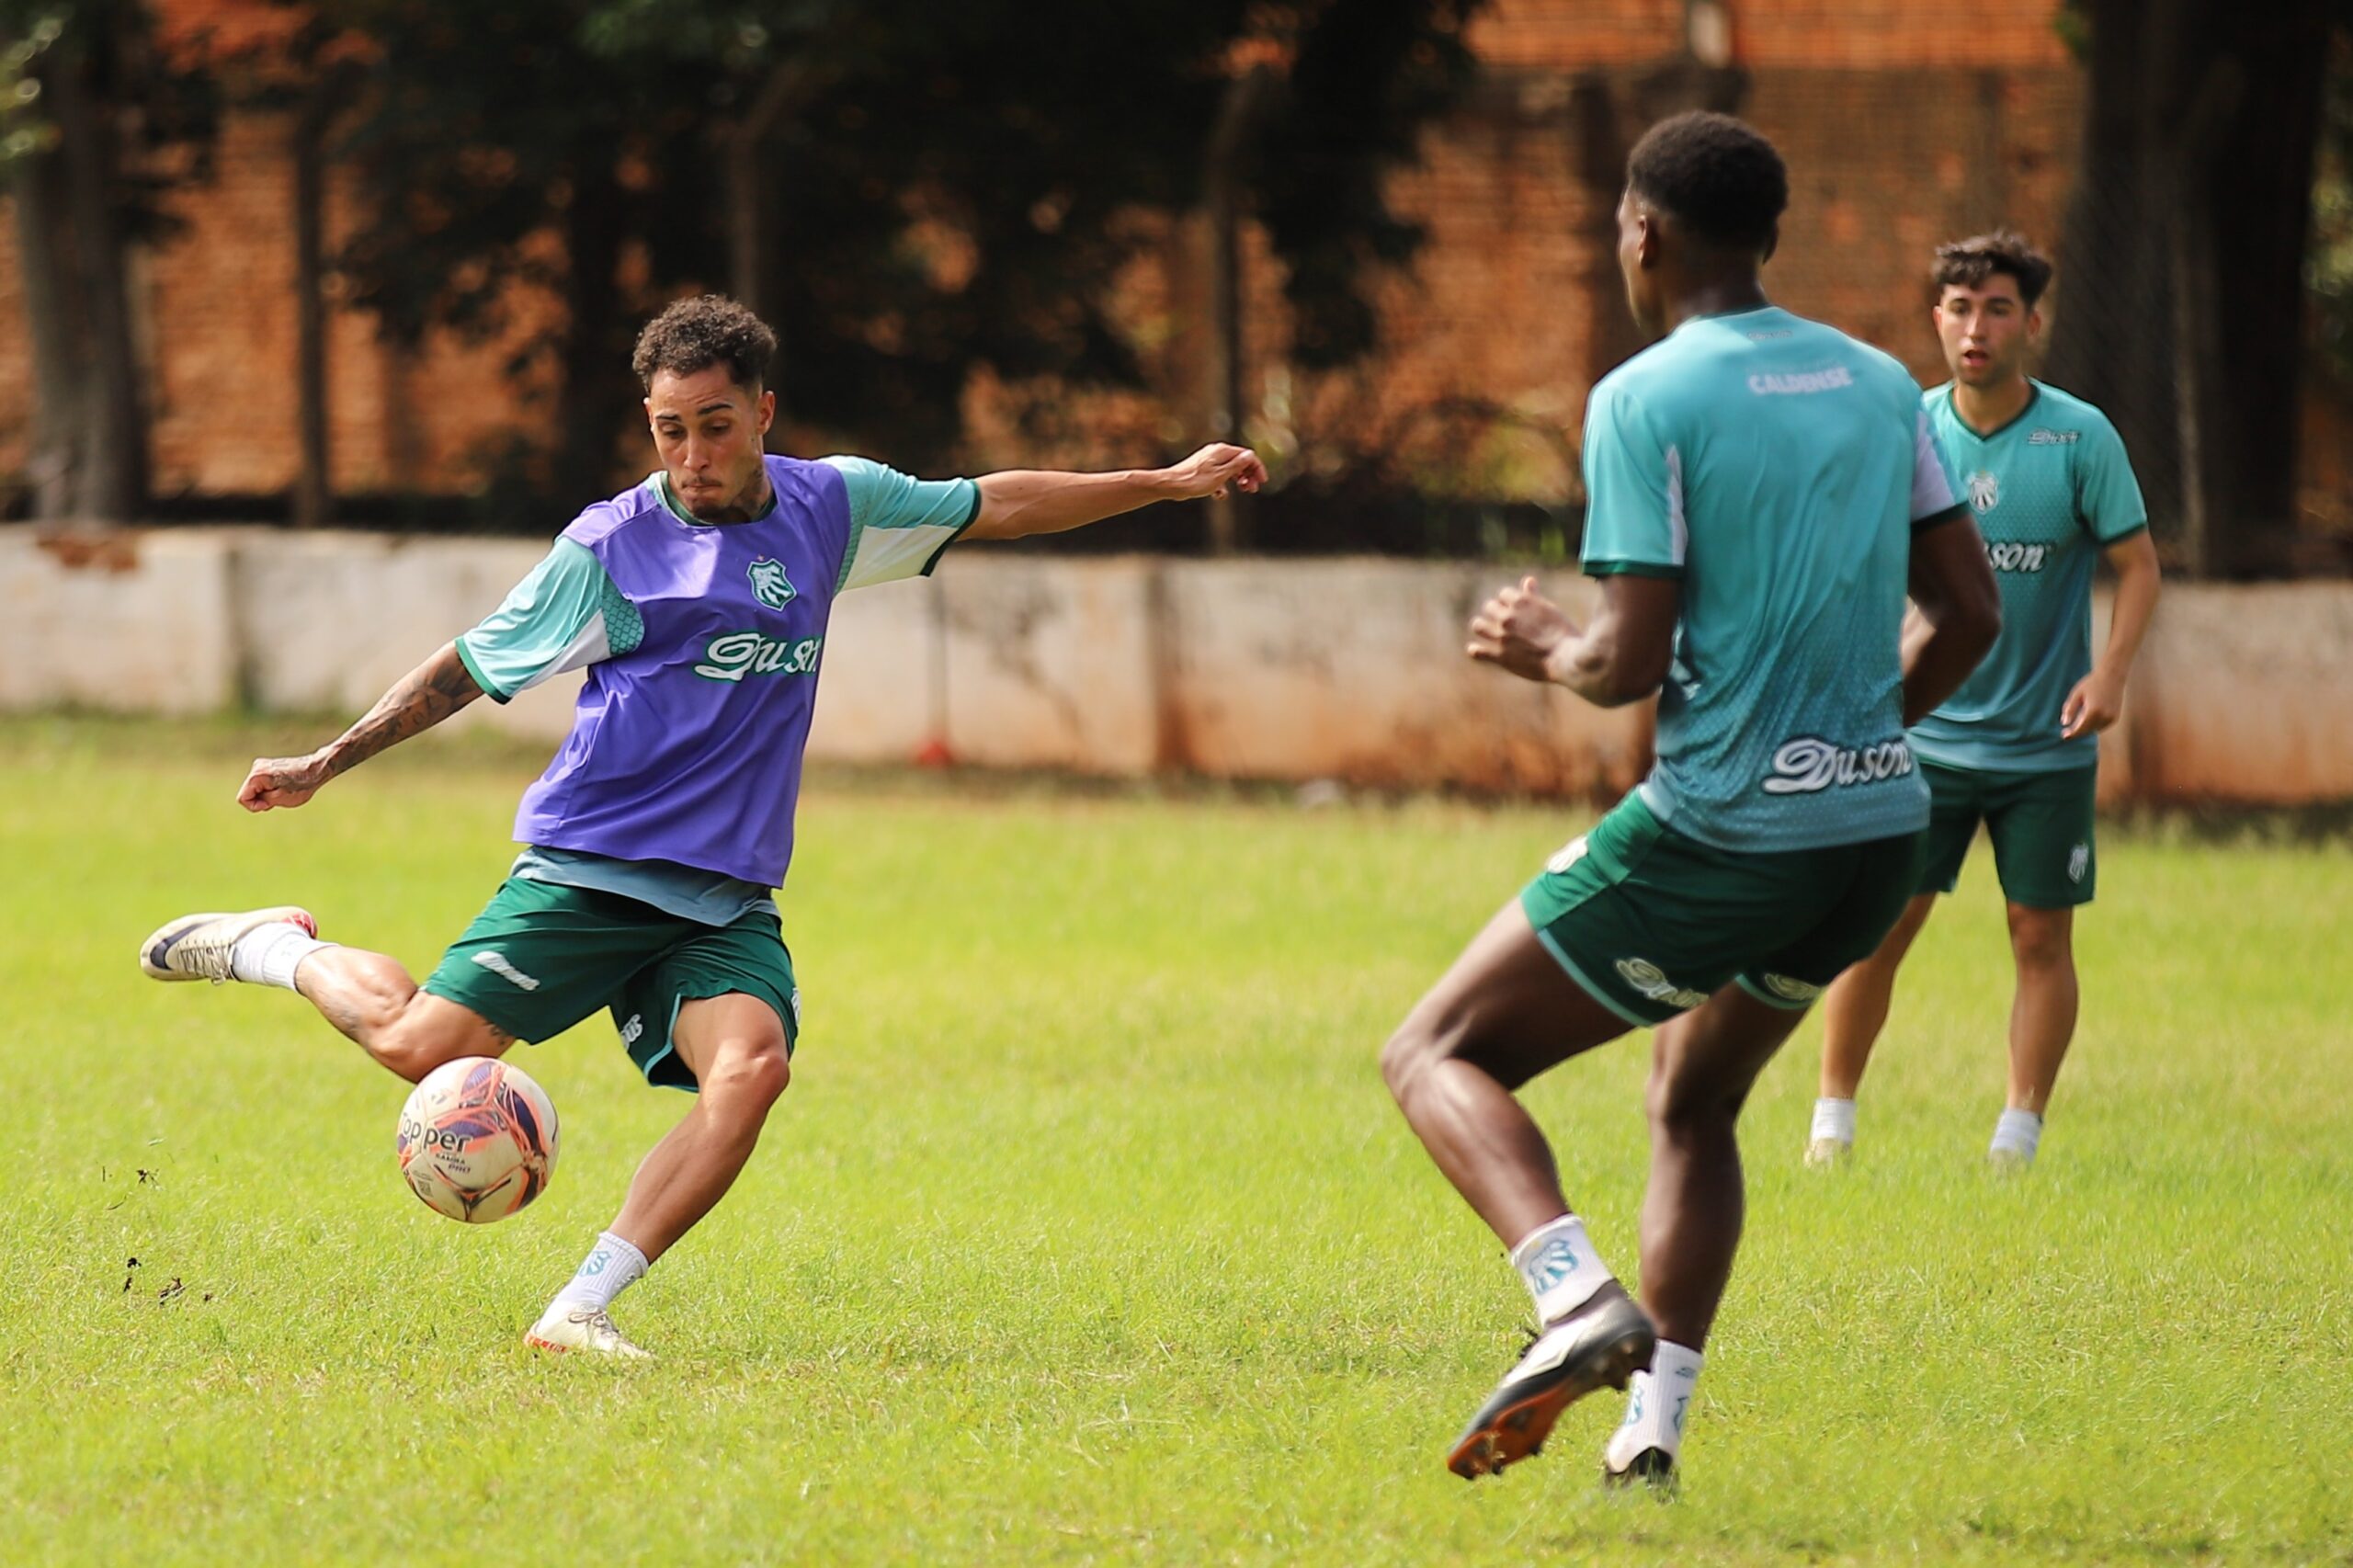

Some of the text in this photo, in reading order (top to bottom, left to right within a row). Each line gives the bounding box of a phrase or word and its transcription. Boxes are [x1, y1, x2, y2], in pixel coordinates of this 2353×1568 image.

[1748, 368, 1853, 395] CALDENSE
[1984, 541, 2046, 573] son
[1762, 738, 1913, 792] Duson
